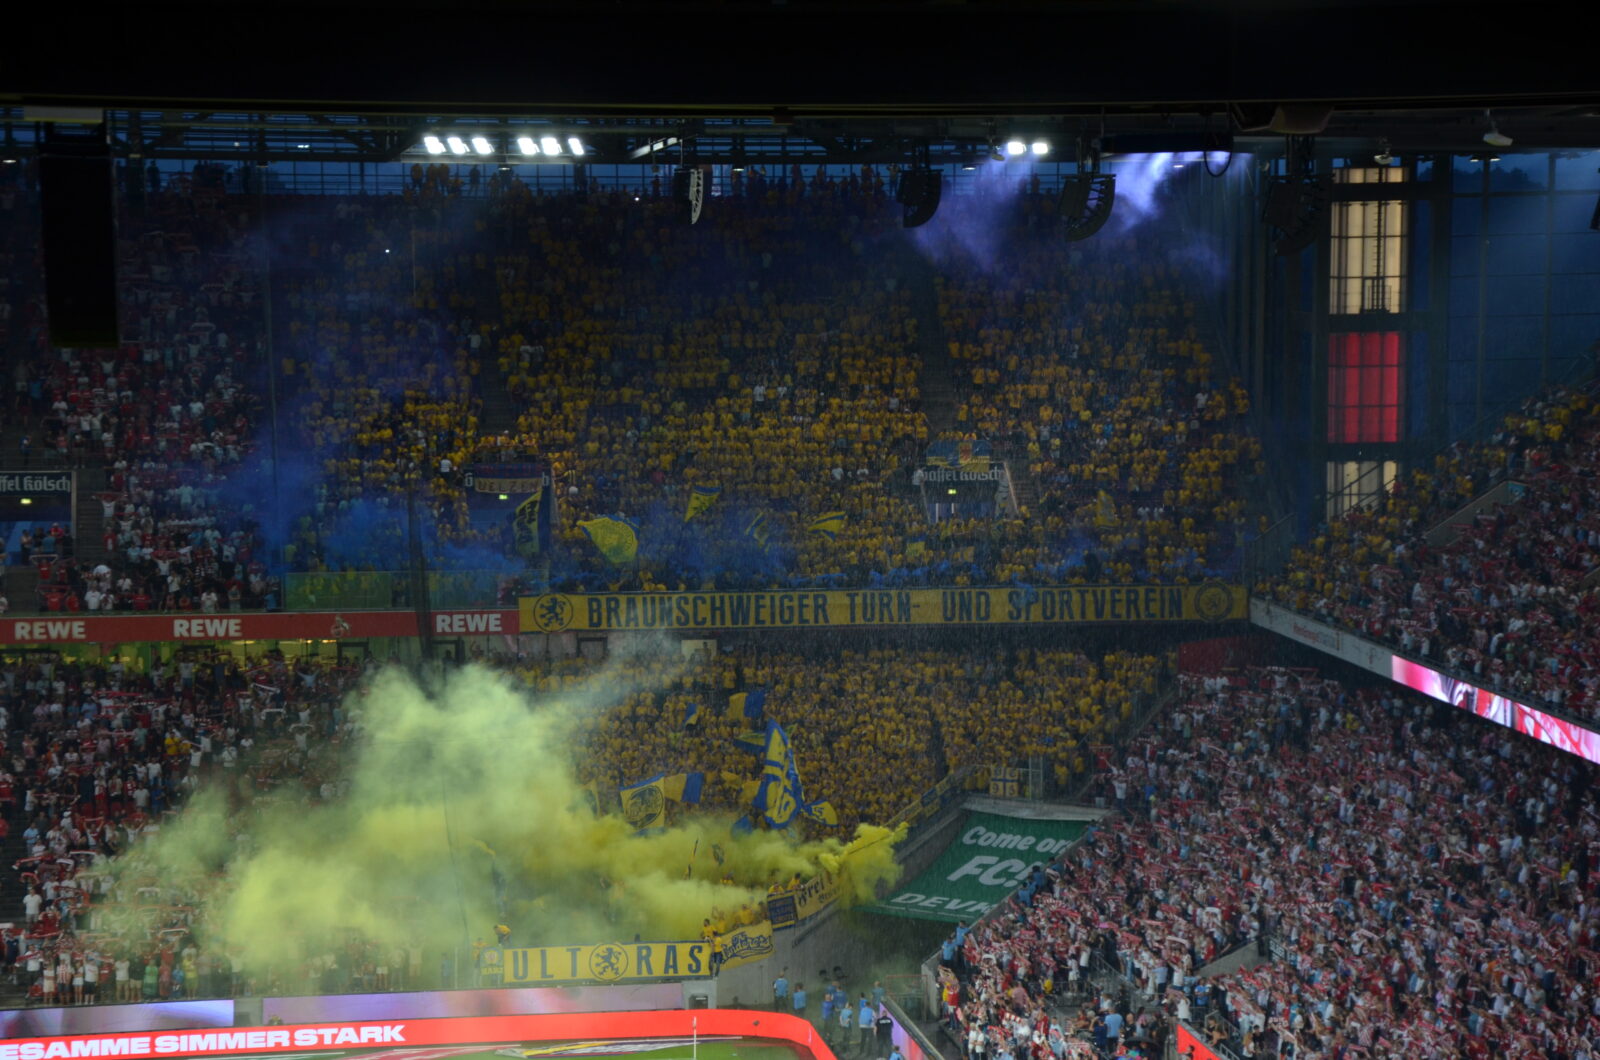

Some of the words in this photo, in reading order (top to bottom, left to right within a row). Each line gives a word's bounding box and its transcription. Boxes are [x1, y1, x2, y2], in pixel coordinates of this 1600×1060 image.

[23, 475, 71, 493] Kölsch
[588, 593, 830, 628] BRAUNSCHWEIGER
[846, 591, 921, 624] TURN-
[942, 590, 990, 622] UND
[1008, 588, 1183, 621] SPORTVEREIN
[14, 621, 86, 640] REWE
[173, 619, 242, 638] REWE
[436, 614, 502, 633] REWE
[962, 826, 1036, 851] Come
[947, 855, 1043, 888] FC!
[155, 1029, 290, 1054] SIMMER
[294, 1024, 405, 1047] STARK
